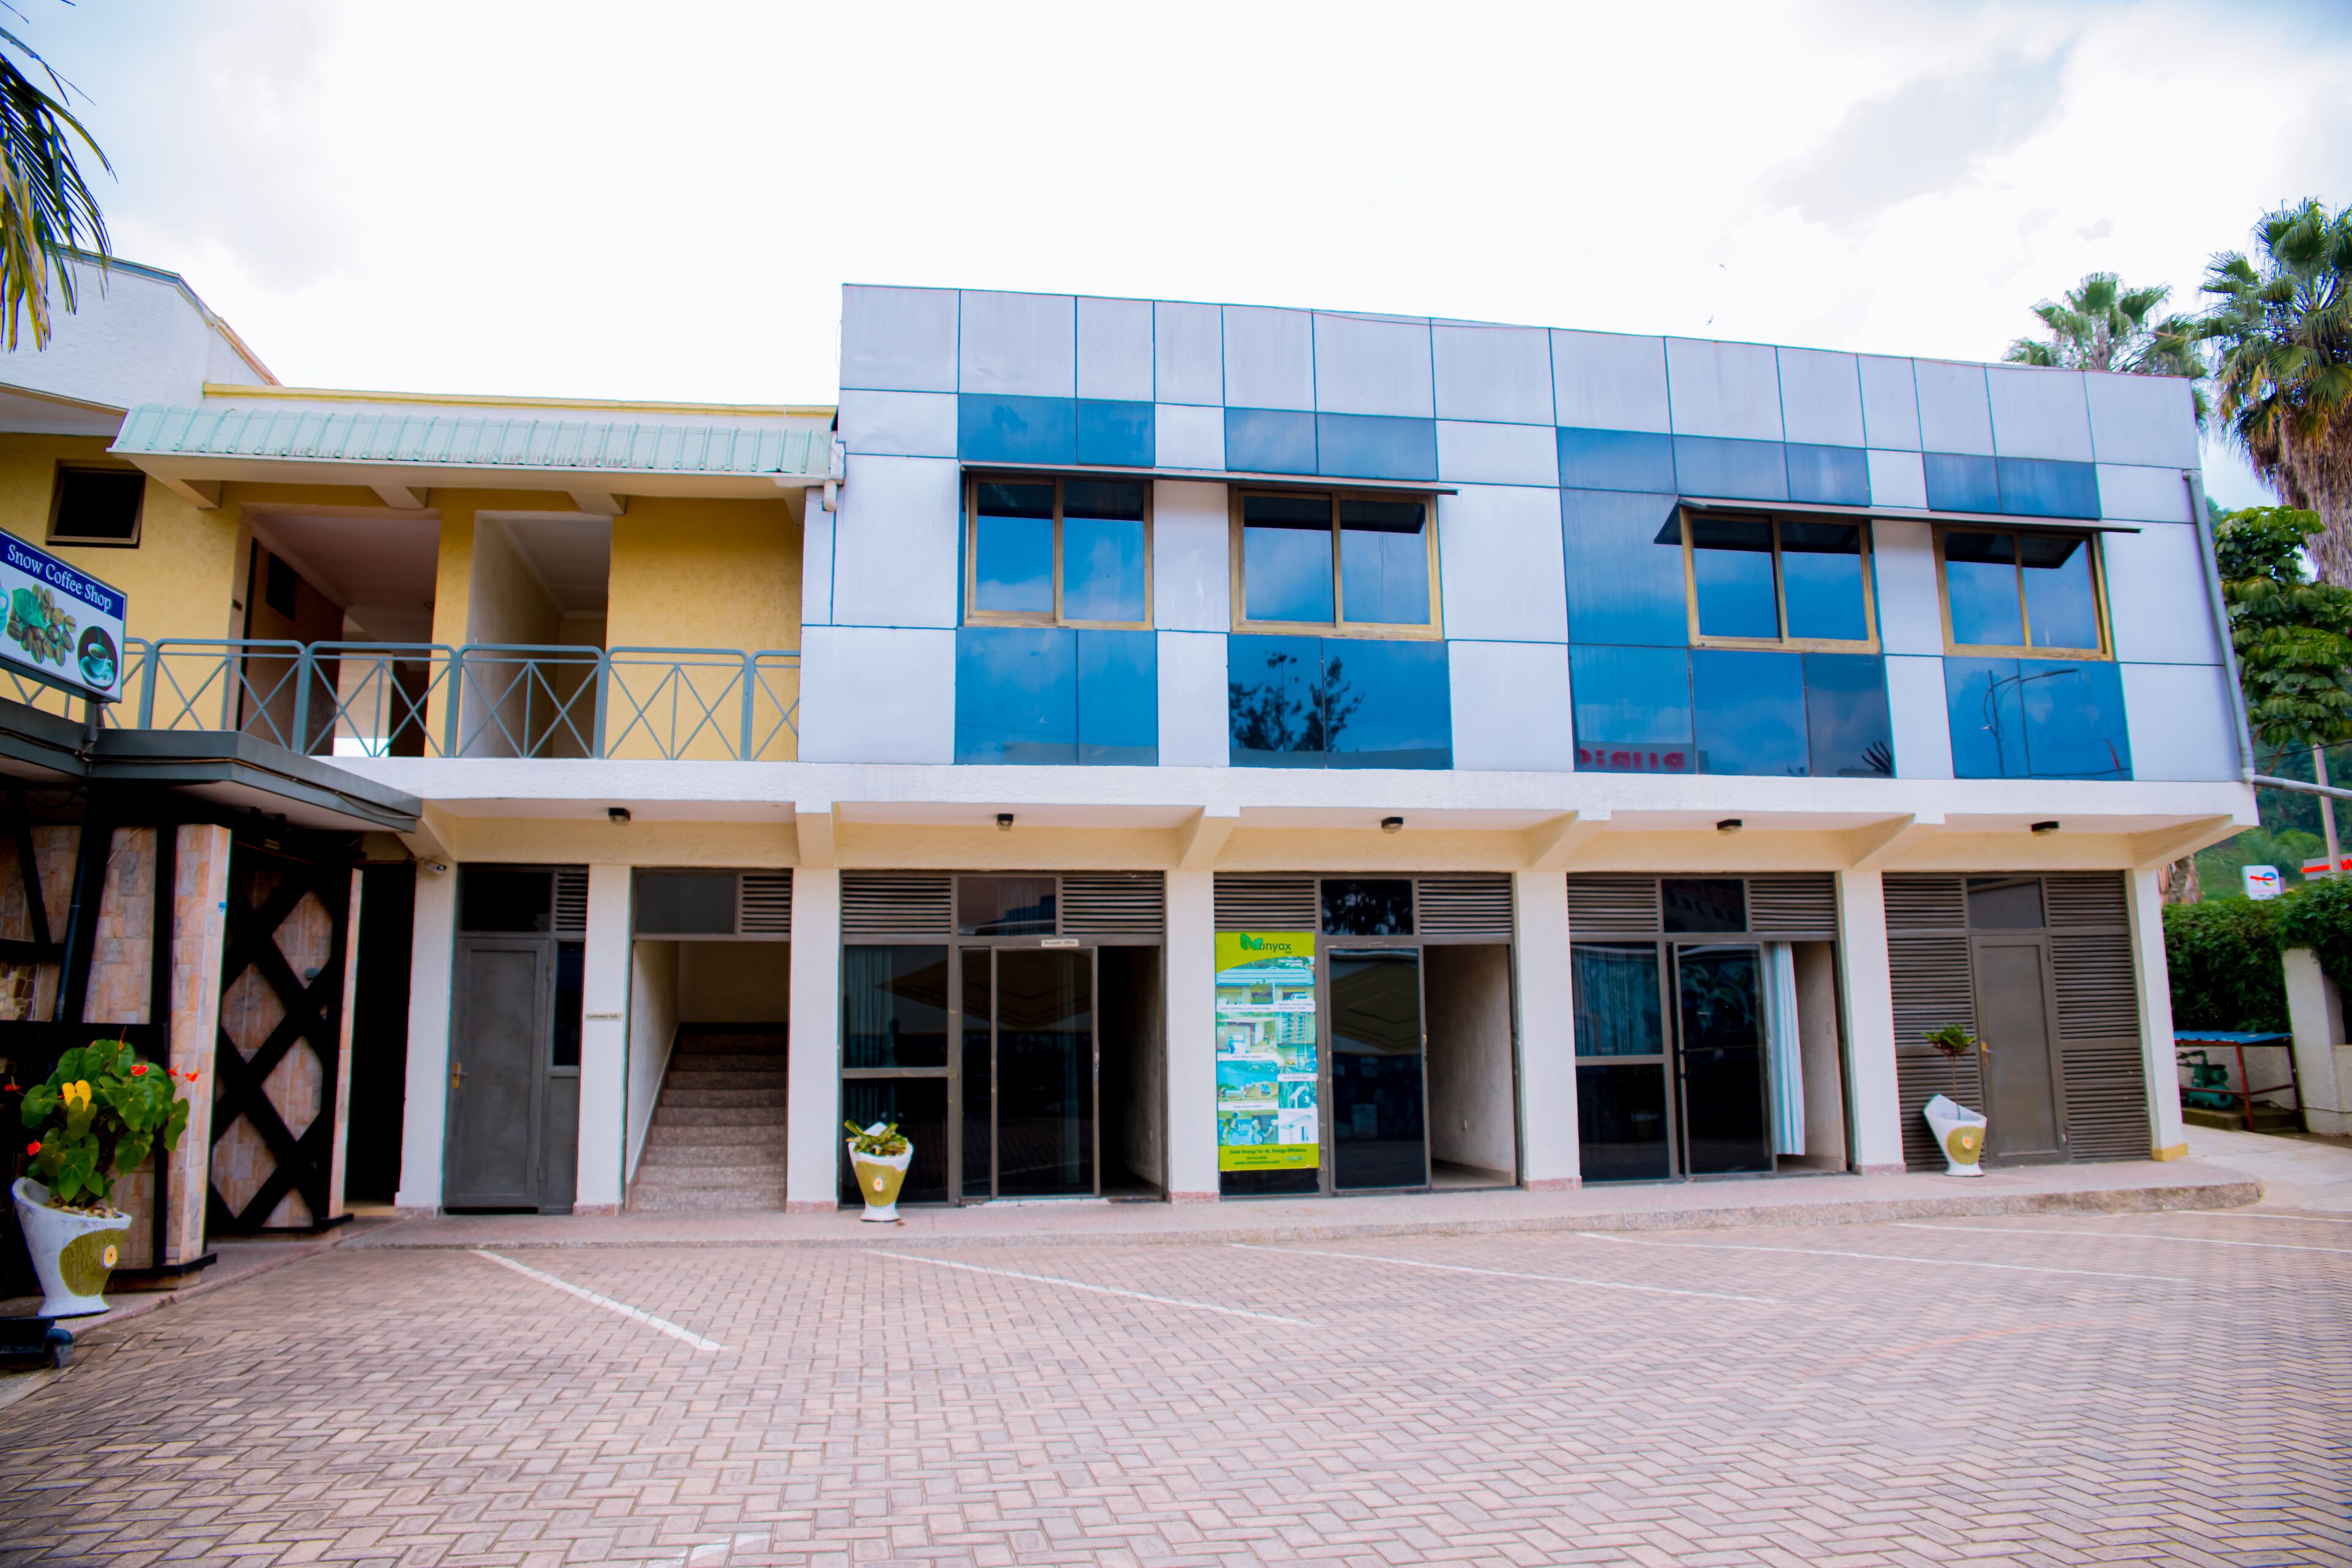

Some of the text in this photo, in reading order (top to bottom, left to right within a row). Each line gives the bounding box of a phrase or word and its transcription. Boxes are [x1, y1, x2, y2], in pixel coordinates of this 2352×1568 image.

[8, 544, 112, 612] Snow Coffee Shop
[1240, 933, 1291, 953] Munyax
